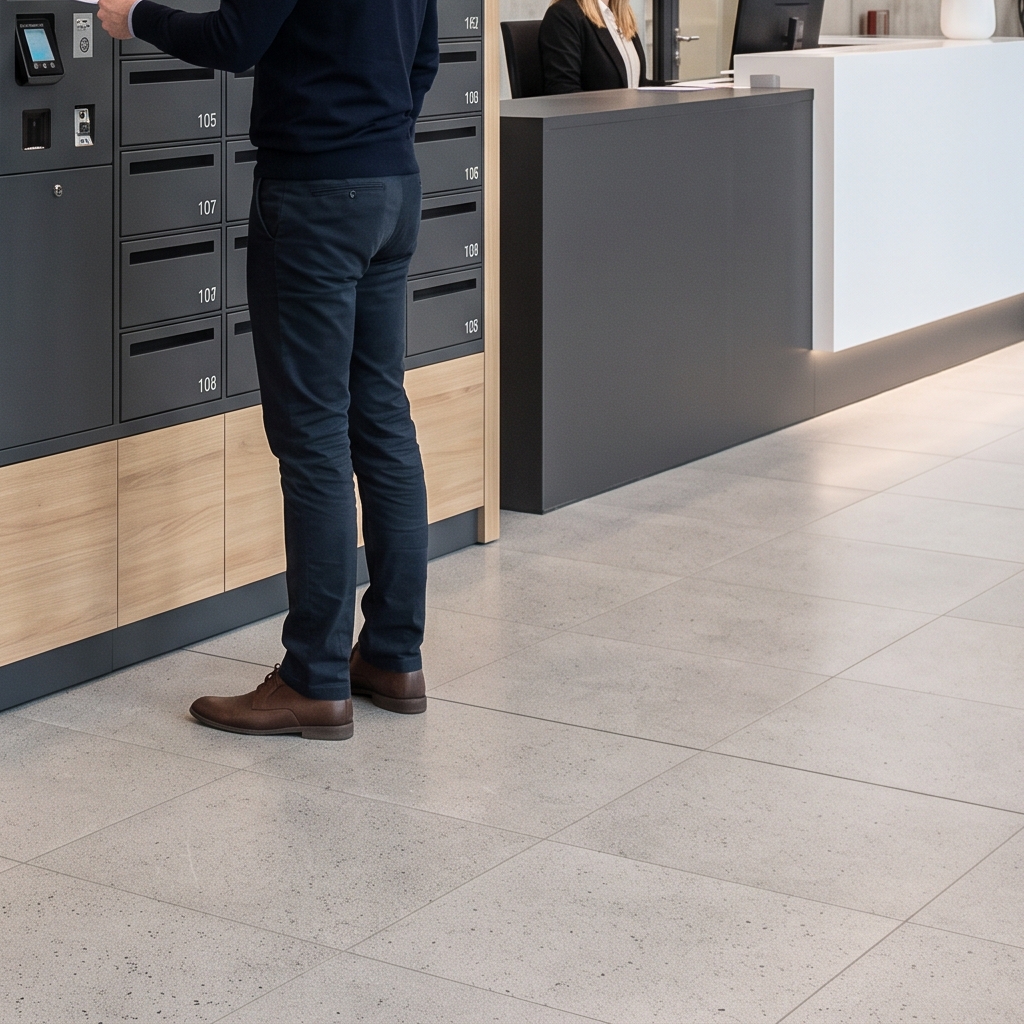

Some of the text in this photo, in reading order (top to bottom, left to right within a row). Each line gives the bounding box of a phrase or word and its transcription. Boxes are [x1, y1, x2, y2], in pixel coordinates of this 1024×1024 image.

[197, 112, 217, 128] 105
[198, 199, 217, 216] 107
[198, 375, 217, 393] 108
